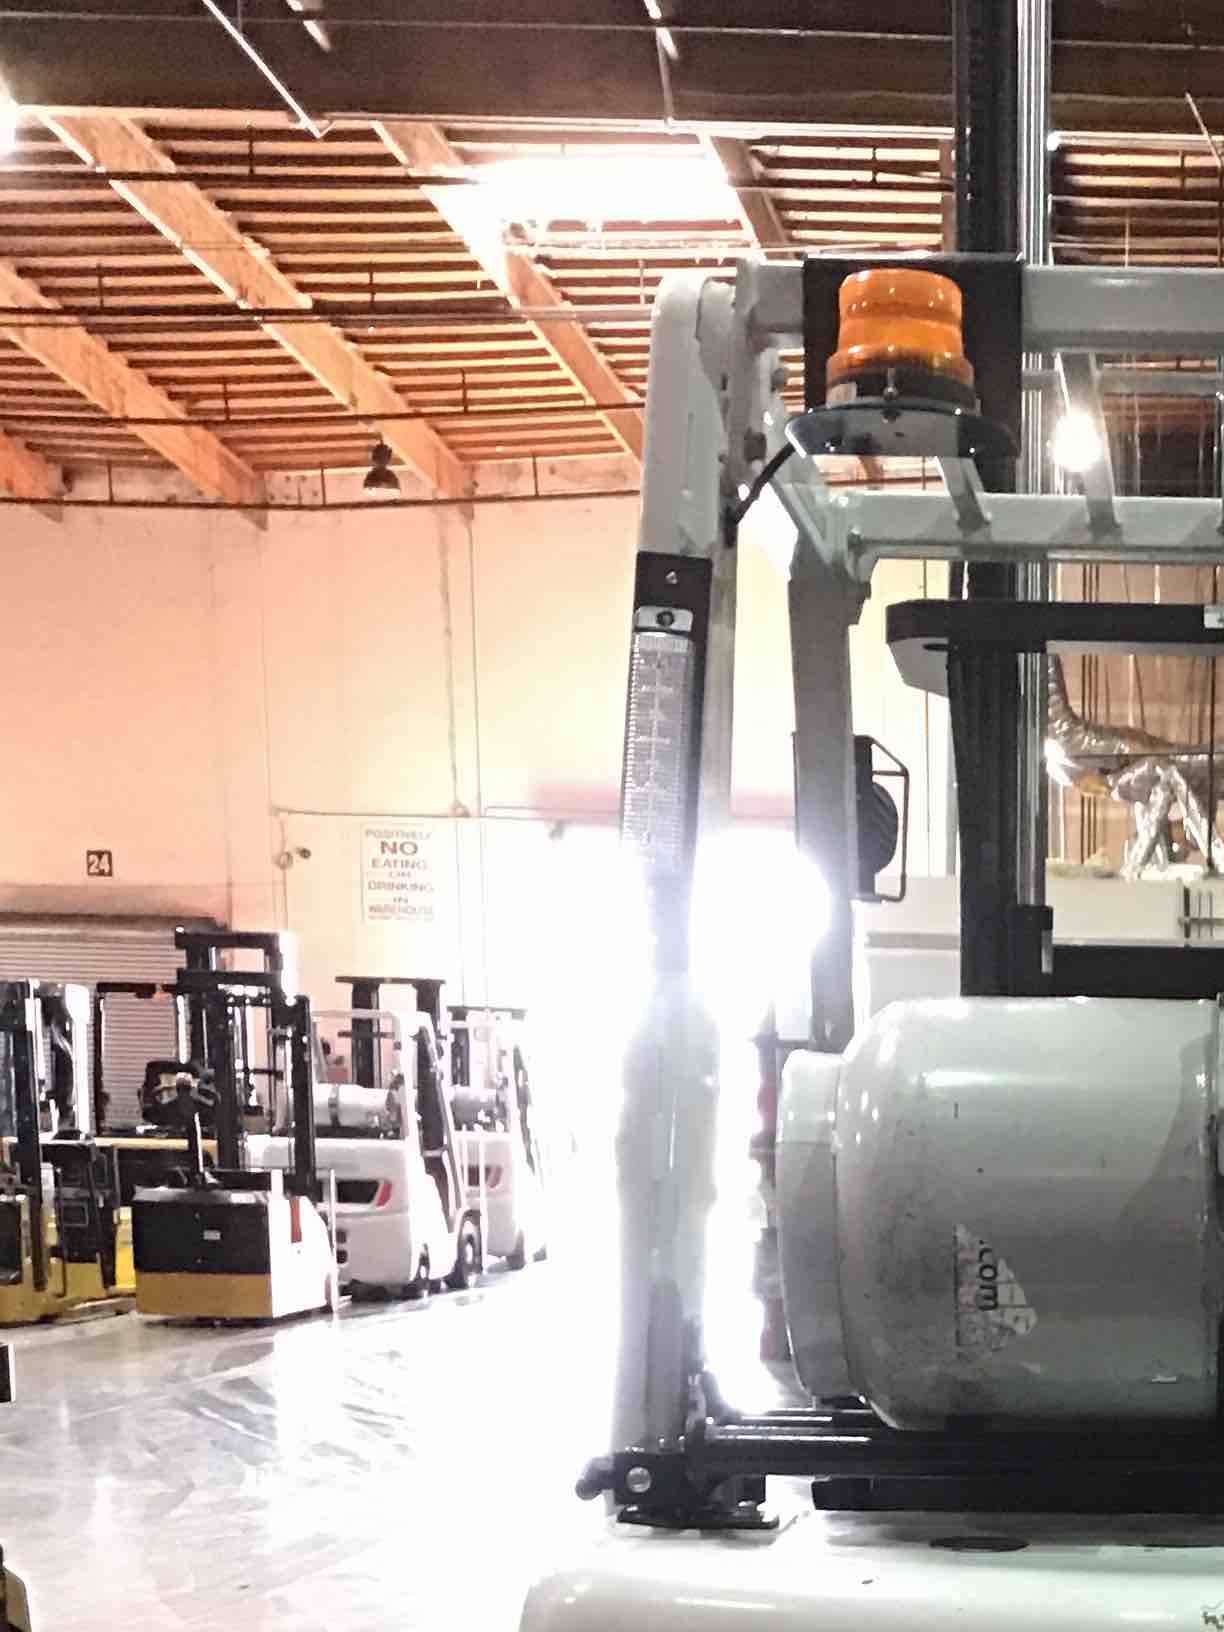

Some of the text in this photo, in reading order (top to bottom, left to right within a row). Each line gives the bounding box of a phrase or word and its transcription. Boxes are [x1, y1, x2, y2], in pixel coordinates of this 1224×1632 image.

[380, 841, 418, 855] NO
[89, 854, 110, 873] 24
[371, 858, 427, 869] EATING
